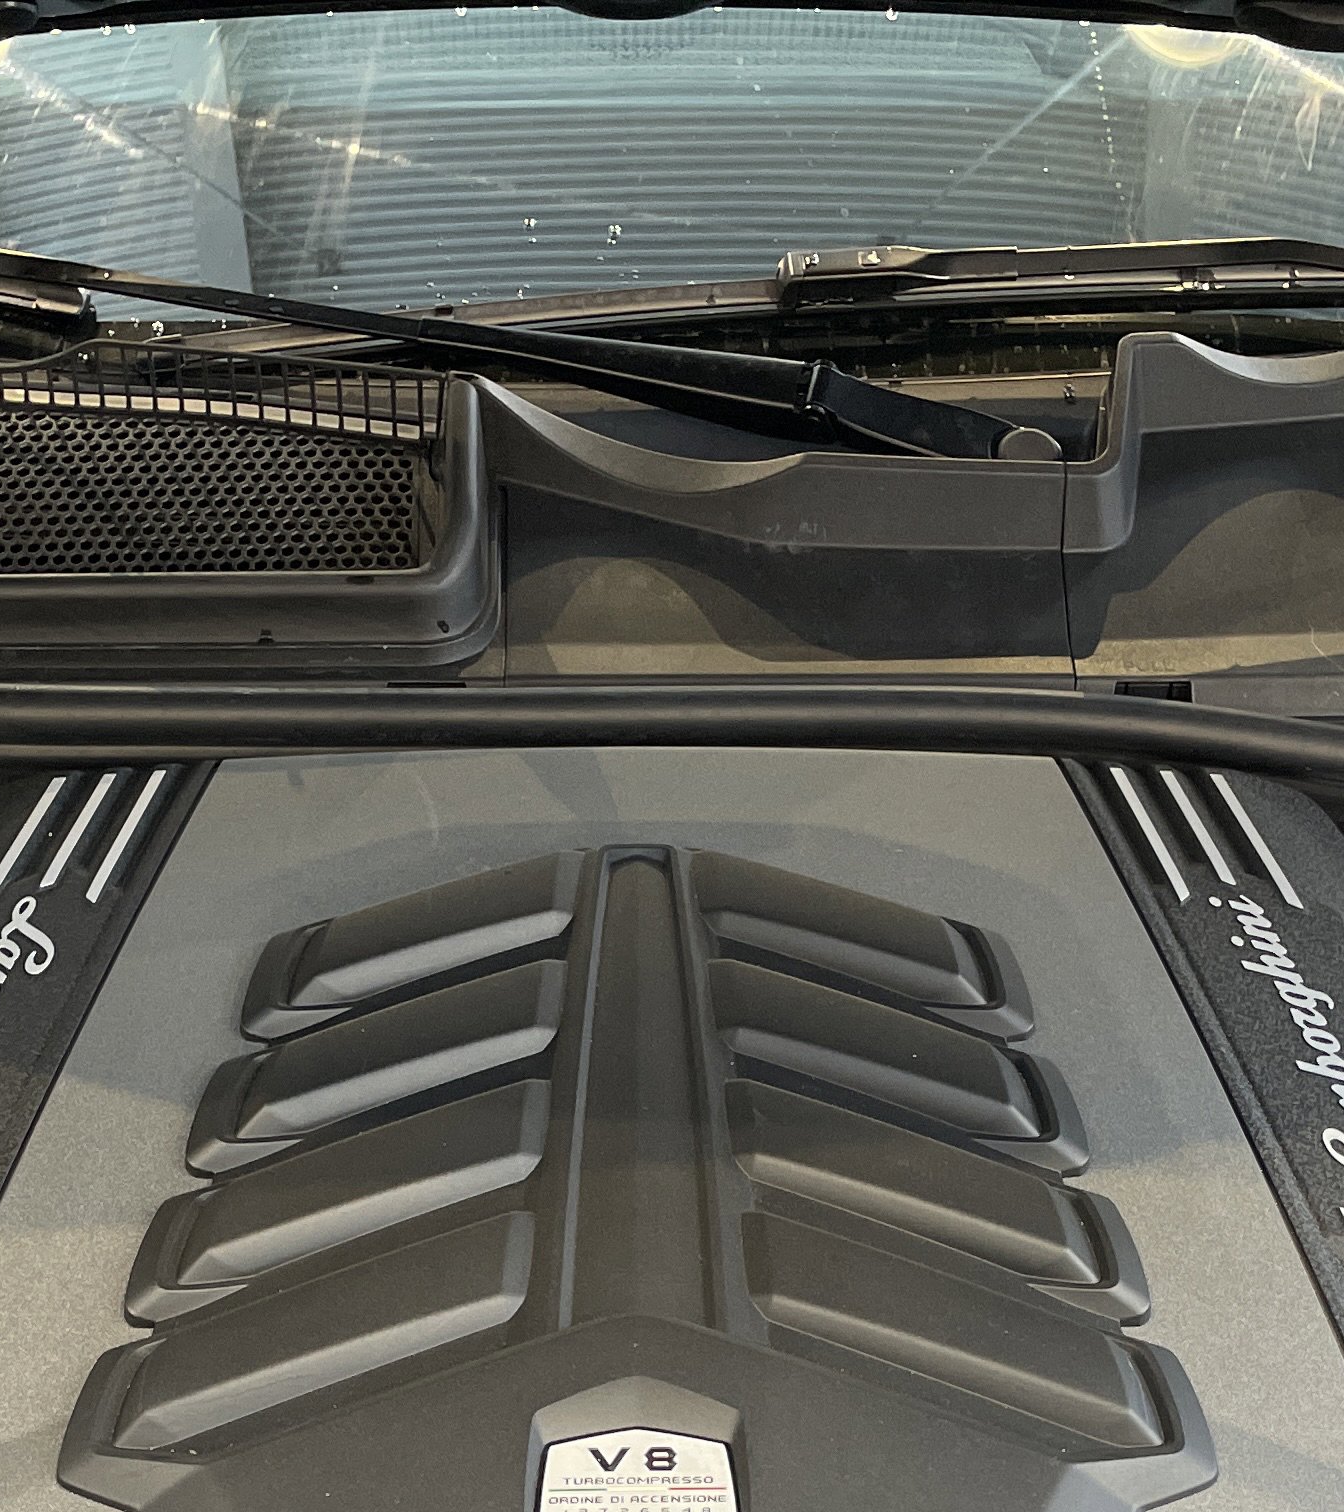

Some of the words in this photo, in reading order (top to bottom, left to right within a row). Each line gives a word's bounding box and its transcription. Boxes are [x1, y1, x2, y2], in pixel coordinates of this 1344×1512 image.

[564, 1476, 713, 1485] TURBOCOMPRESSO
[548, 1496, 603, 1504] ORDINE
[611, 1495, 625, 1504] DI
[630, 1494, 727, 1504] ACCENSIONE
